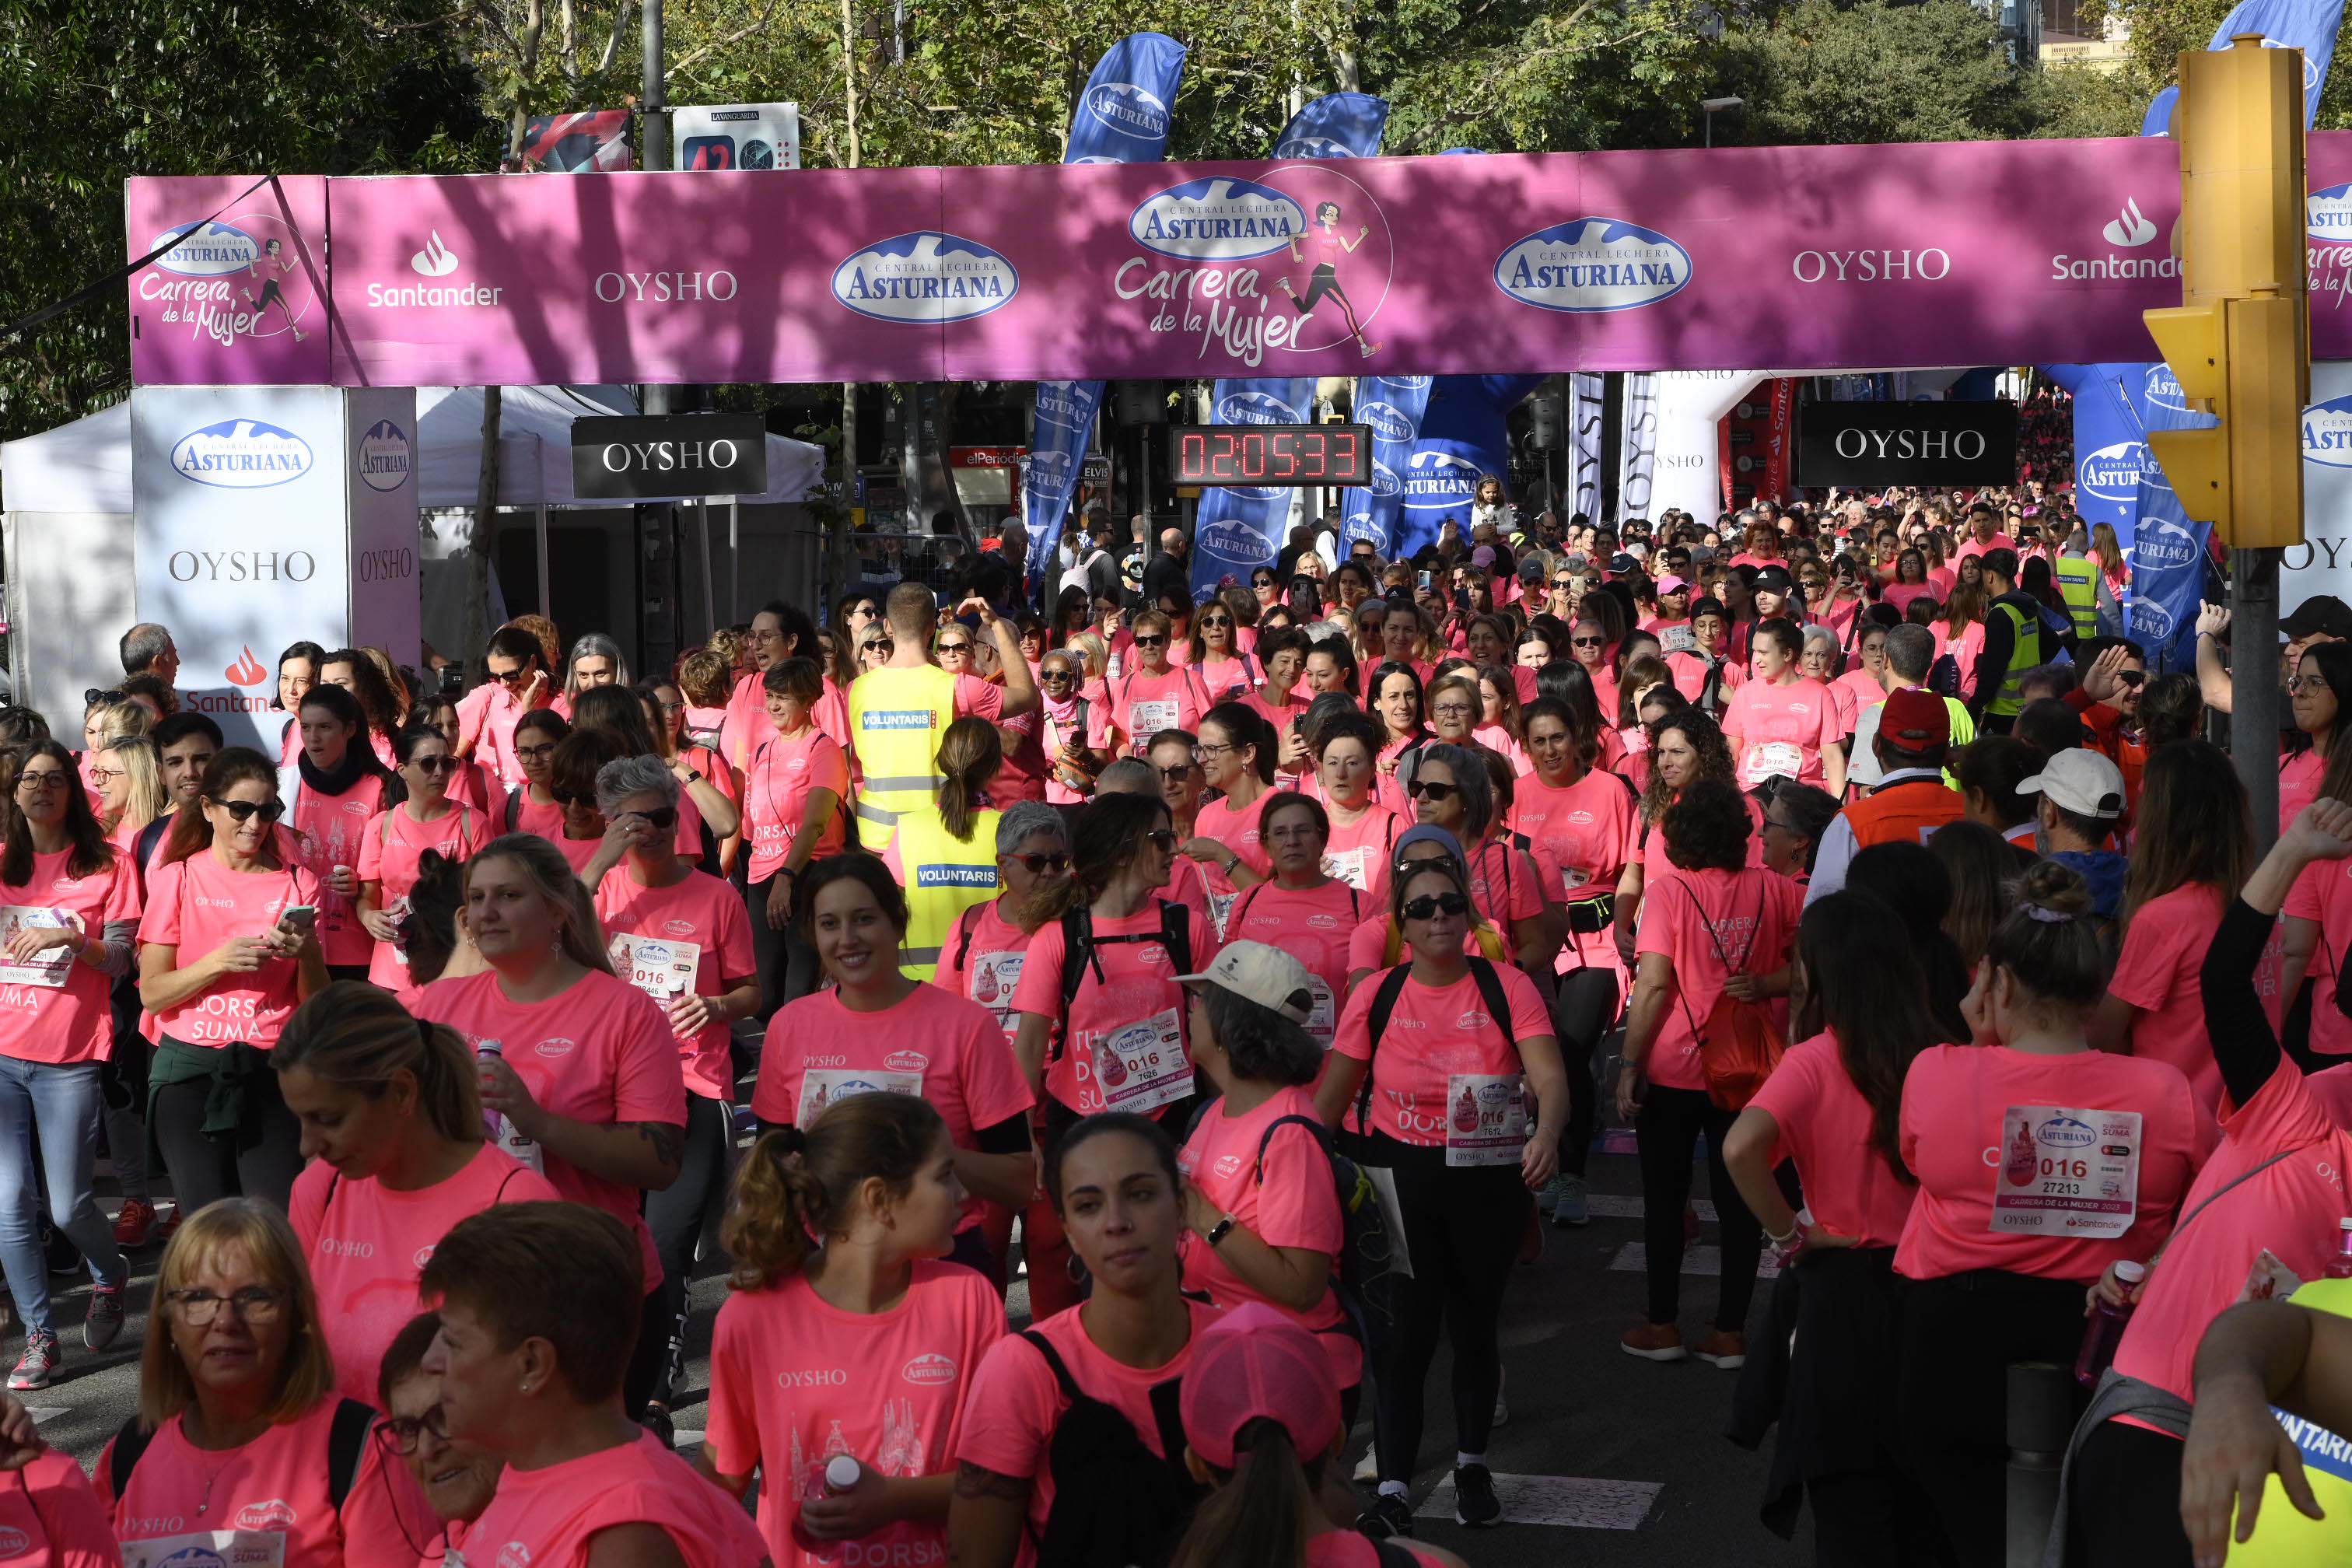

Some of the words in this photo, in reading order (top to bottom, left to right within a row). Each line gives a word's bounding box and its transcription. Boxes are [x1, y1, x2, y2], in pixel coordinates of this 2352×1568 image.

[1092, 90, 1165, 135] ASTURIANA
[1170, 206, 1227, 215] CENTRAL
[1231, 205, 1287, 213] LECHERA
[1143, 208, 1292, 240] ASTURIANA
[1540, 250, 1601, 261] CENTRAL
[1608, 249, 1671, 259] LECHERA
[1793, 247, 1951, 282] OYSHO
[875, 264, 933, 272] CENTRAL
[939, 263, 998, 271] LECHERA
[1509, 254, 1677, 289] ASTURIANA
[140, 273, 230, 300] Carrera
[594, 271, 738, 303] OYSHO
[846, 266, 1004, 299] ASTURIANA
[1115, 257, 1260, 299] Carrera
[2325, 270, 2339, 291] la
[367, 282, 502, 306] Santander
[162, 303, 179, 323] de
[182, 302, 195, 323] la
[1150, 303, 1177, 332] de
[1183, 301, 1202, 332] la
[193, 299, 266, 347] Mujer
[1199, 296, 1314, 368] Mujer
[1835, 428, 1986, 460] OYSHO
[182, 444, 303, 471] ASTURIANA
[362, 446, 408, 474] ASTURIANA
[602, 439, 738, 473] OYSHO
[967, 452, 1023, 464] elPeriódi
[1182, 435, 1356, 476] 02:05:33
[1656, 455, 1703, 467] YSHO
[1084, 467, 1108, 477] ELVIS
[2086, 464, 2140, 486] ASTUR
[1405, 478, 1477, 495] TURIANA
[1202, 530, 1268, 564] ASTURIANA
[169, 551, 315, 582] OYSHO
[360, 548, 411, 583] OYSHO
[863, 713, 929, 726] VOLUNTARIS
[1520, 814, 1545, 822] OYSHO
[919, 869, 996, 883] VOLUNTARIS
[195, 896, 234, 908] OYSHO
[1249, 916, 1280, 926] OYSHO
[1734, 931, 1750, 944] LA
[639, 950, 668, 961] ASTURIANA
[636, 970, 664, 984] 016
[191, 1020, 264, 1040] SUMA
[1118, 1034, 1154, 1050] ASTURIANA
[887, 1057, 925, 1067] ASTURIANA
[1128, 1052, 1160, 1072] 016
[1138, 1069, 1158, 1081] 7626
[1115, 1087, 1141, 1100] CARRERA
[1157, 1075, 1175, 1086] MUJER
[1079, 1090, 1105, 1109] SU
[1117, 1097, 1146, 1113] OYSHO
[1398, 1110, 1448, 1132] DOR
[1482, 1111, 1504, 1124] 016
[2041, 1129, 2091, 1142] ASTURIANA
[2102, 1128, 2130, 1136] SUMA
[2041, 1158, 2087, 1178] 016
[2043, 1181, 2080, 1195] 27213
[2010, 1198, 2044, 1206] CARRERA
[2070, 1201, 2098, 1209] MUJER
[2004, 1215, 2042, 1226] OYSHO
[2077, 1219, 2123, 1229] Santander
[778, 1368, 847, 1388] OYSHO
[908, 1367, 955, 1379] ASTURIANA
[235, 1554, 269, 1563] SUMA
[844, 1542, 944, 1567] DORSA
